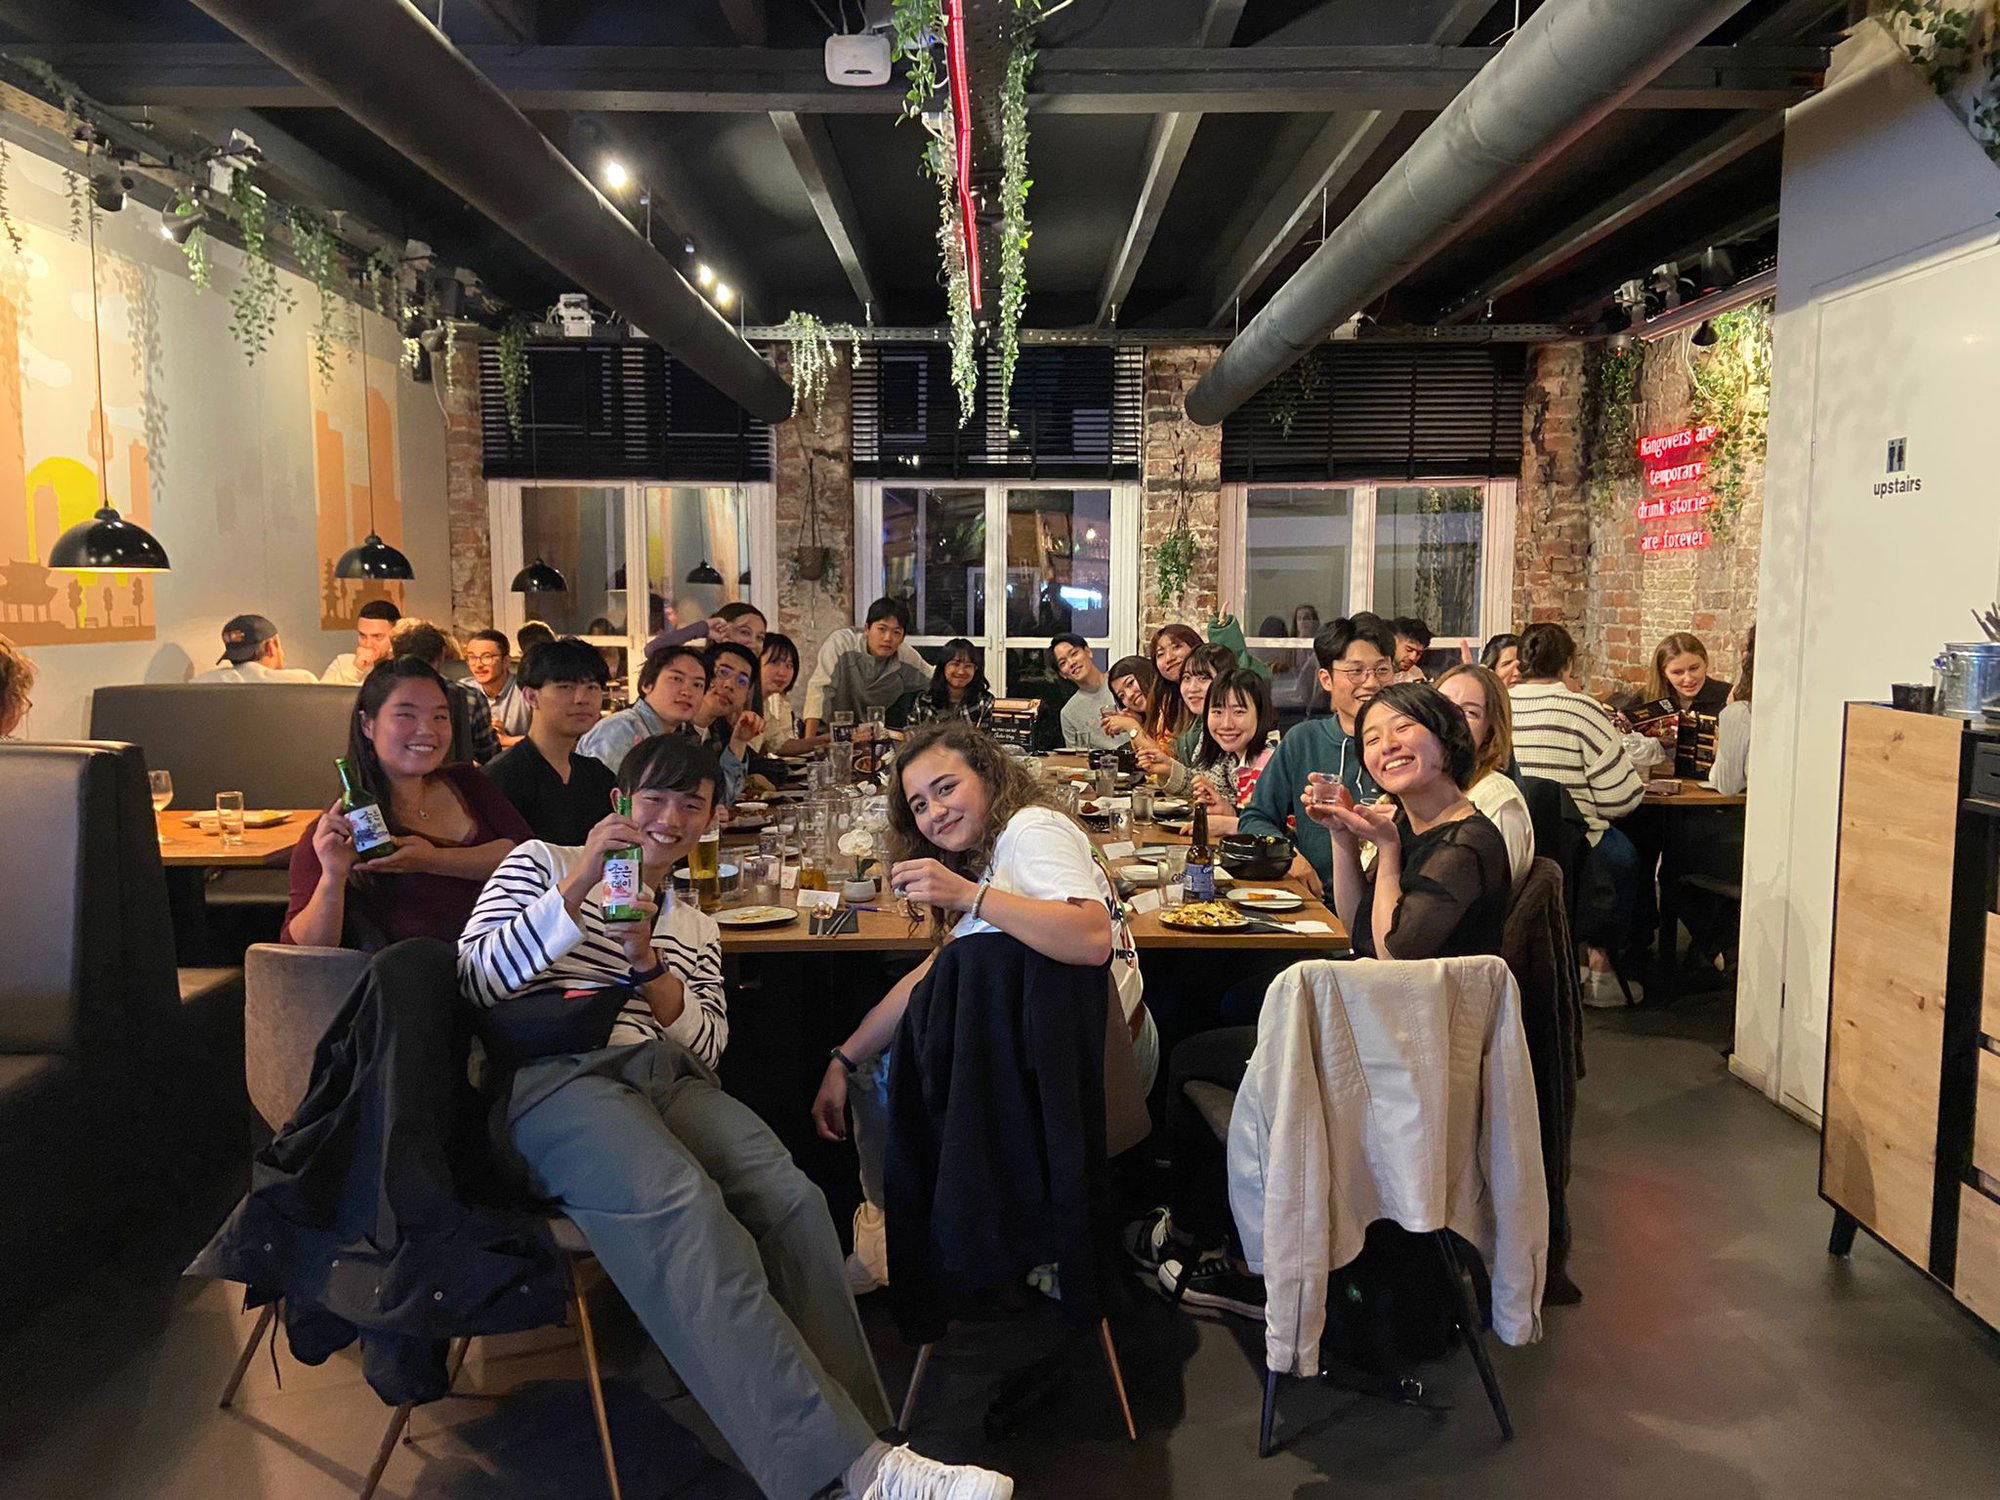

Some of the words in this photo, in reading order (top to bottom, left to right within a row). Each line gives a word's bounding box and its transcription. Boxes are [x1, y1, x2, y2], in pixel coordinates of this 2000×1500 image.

[1640, 431, 1692, 458] Hangovers
[1695, 425, 1716, 442] are
[1650, 462, 1702, 488] temporary
[1873, 475, 1922, 499] upstairs
[1638, 499, 1665, 518] drunk
[1669, 492, 1711, 515] storie
[1641, 536, 1659, 550] are
[1663, 530, 1705, 547] forever
